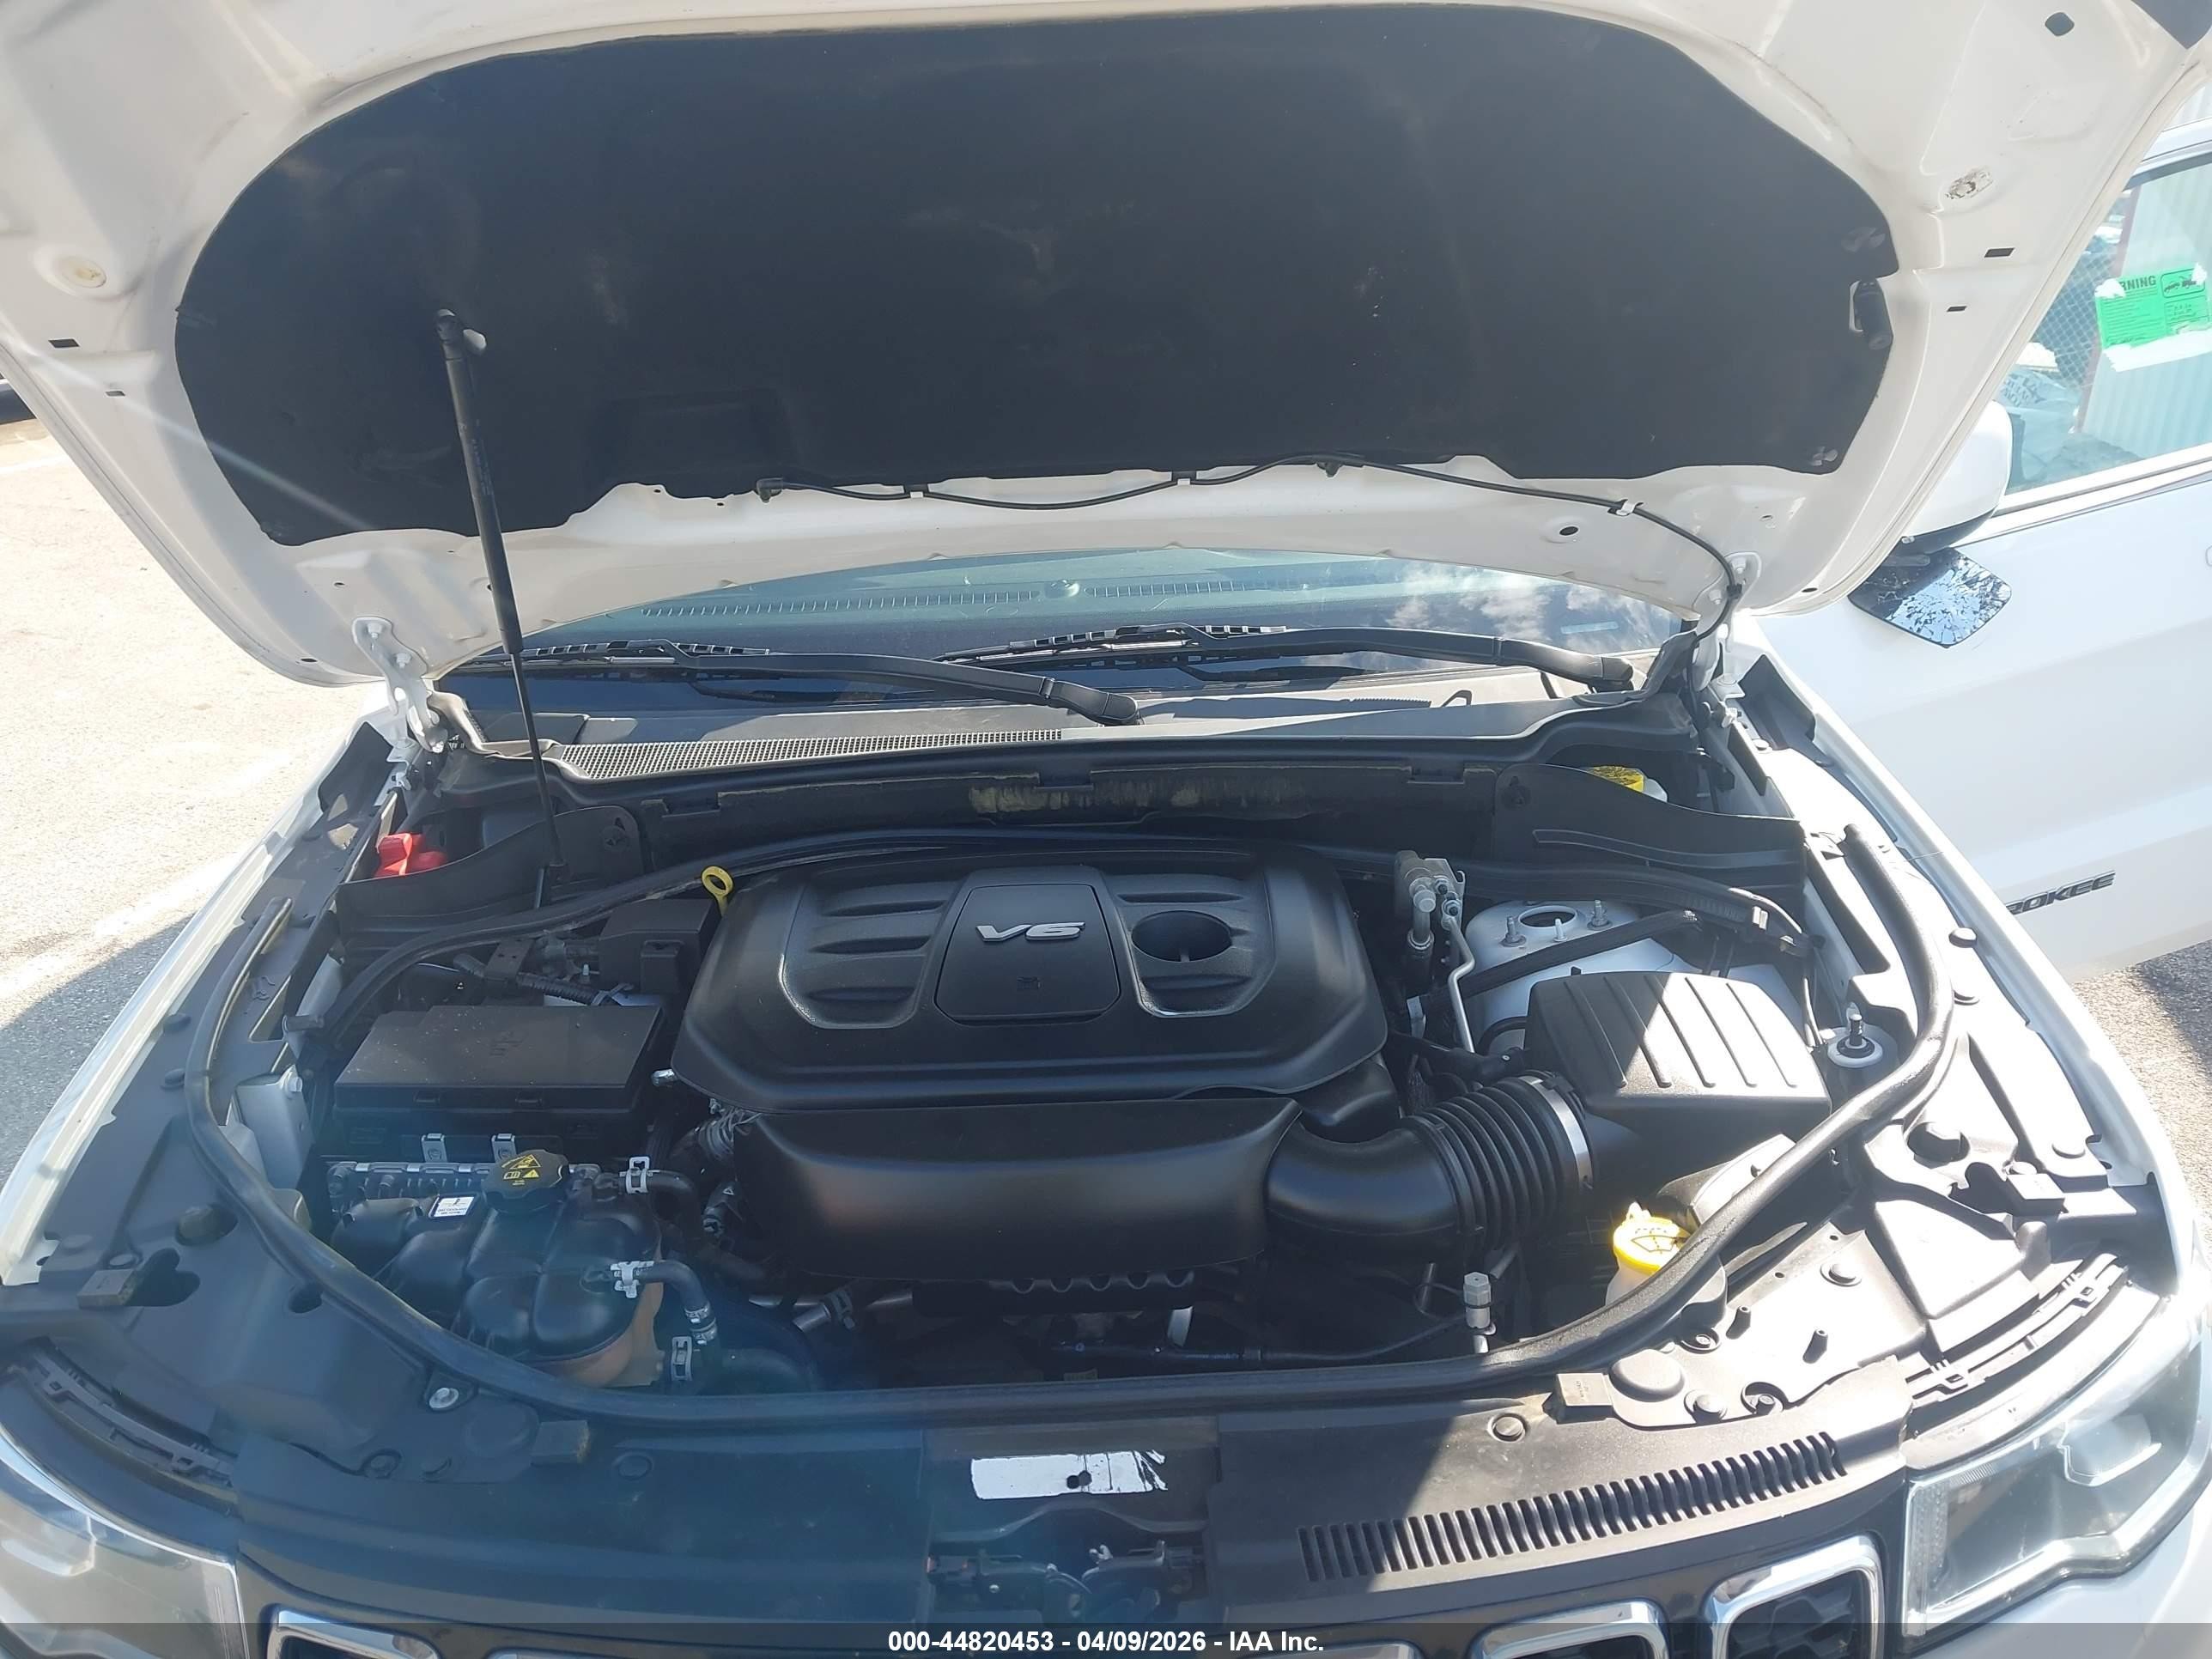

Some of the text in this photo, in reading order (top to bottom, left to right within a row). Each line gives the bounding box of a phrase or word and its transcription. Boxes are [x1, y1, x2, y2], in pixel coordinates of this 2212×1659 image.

[2119, 275, 2156, 291] RNING
[2006, 871, 2115, 915] ROKEE
[975, 921, 1085, 942] V6
